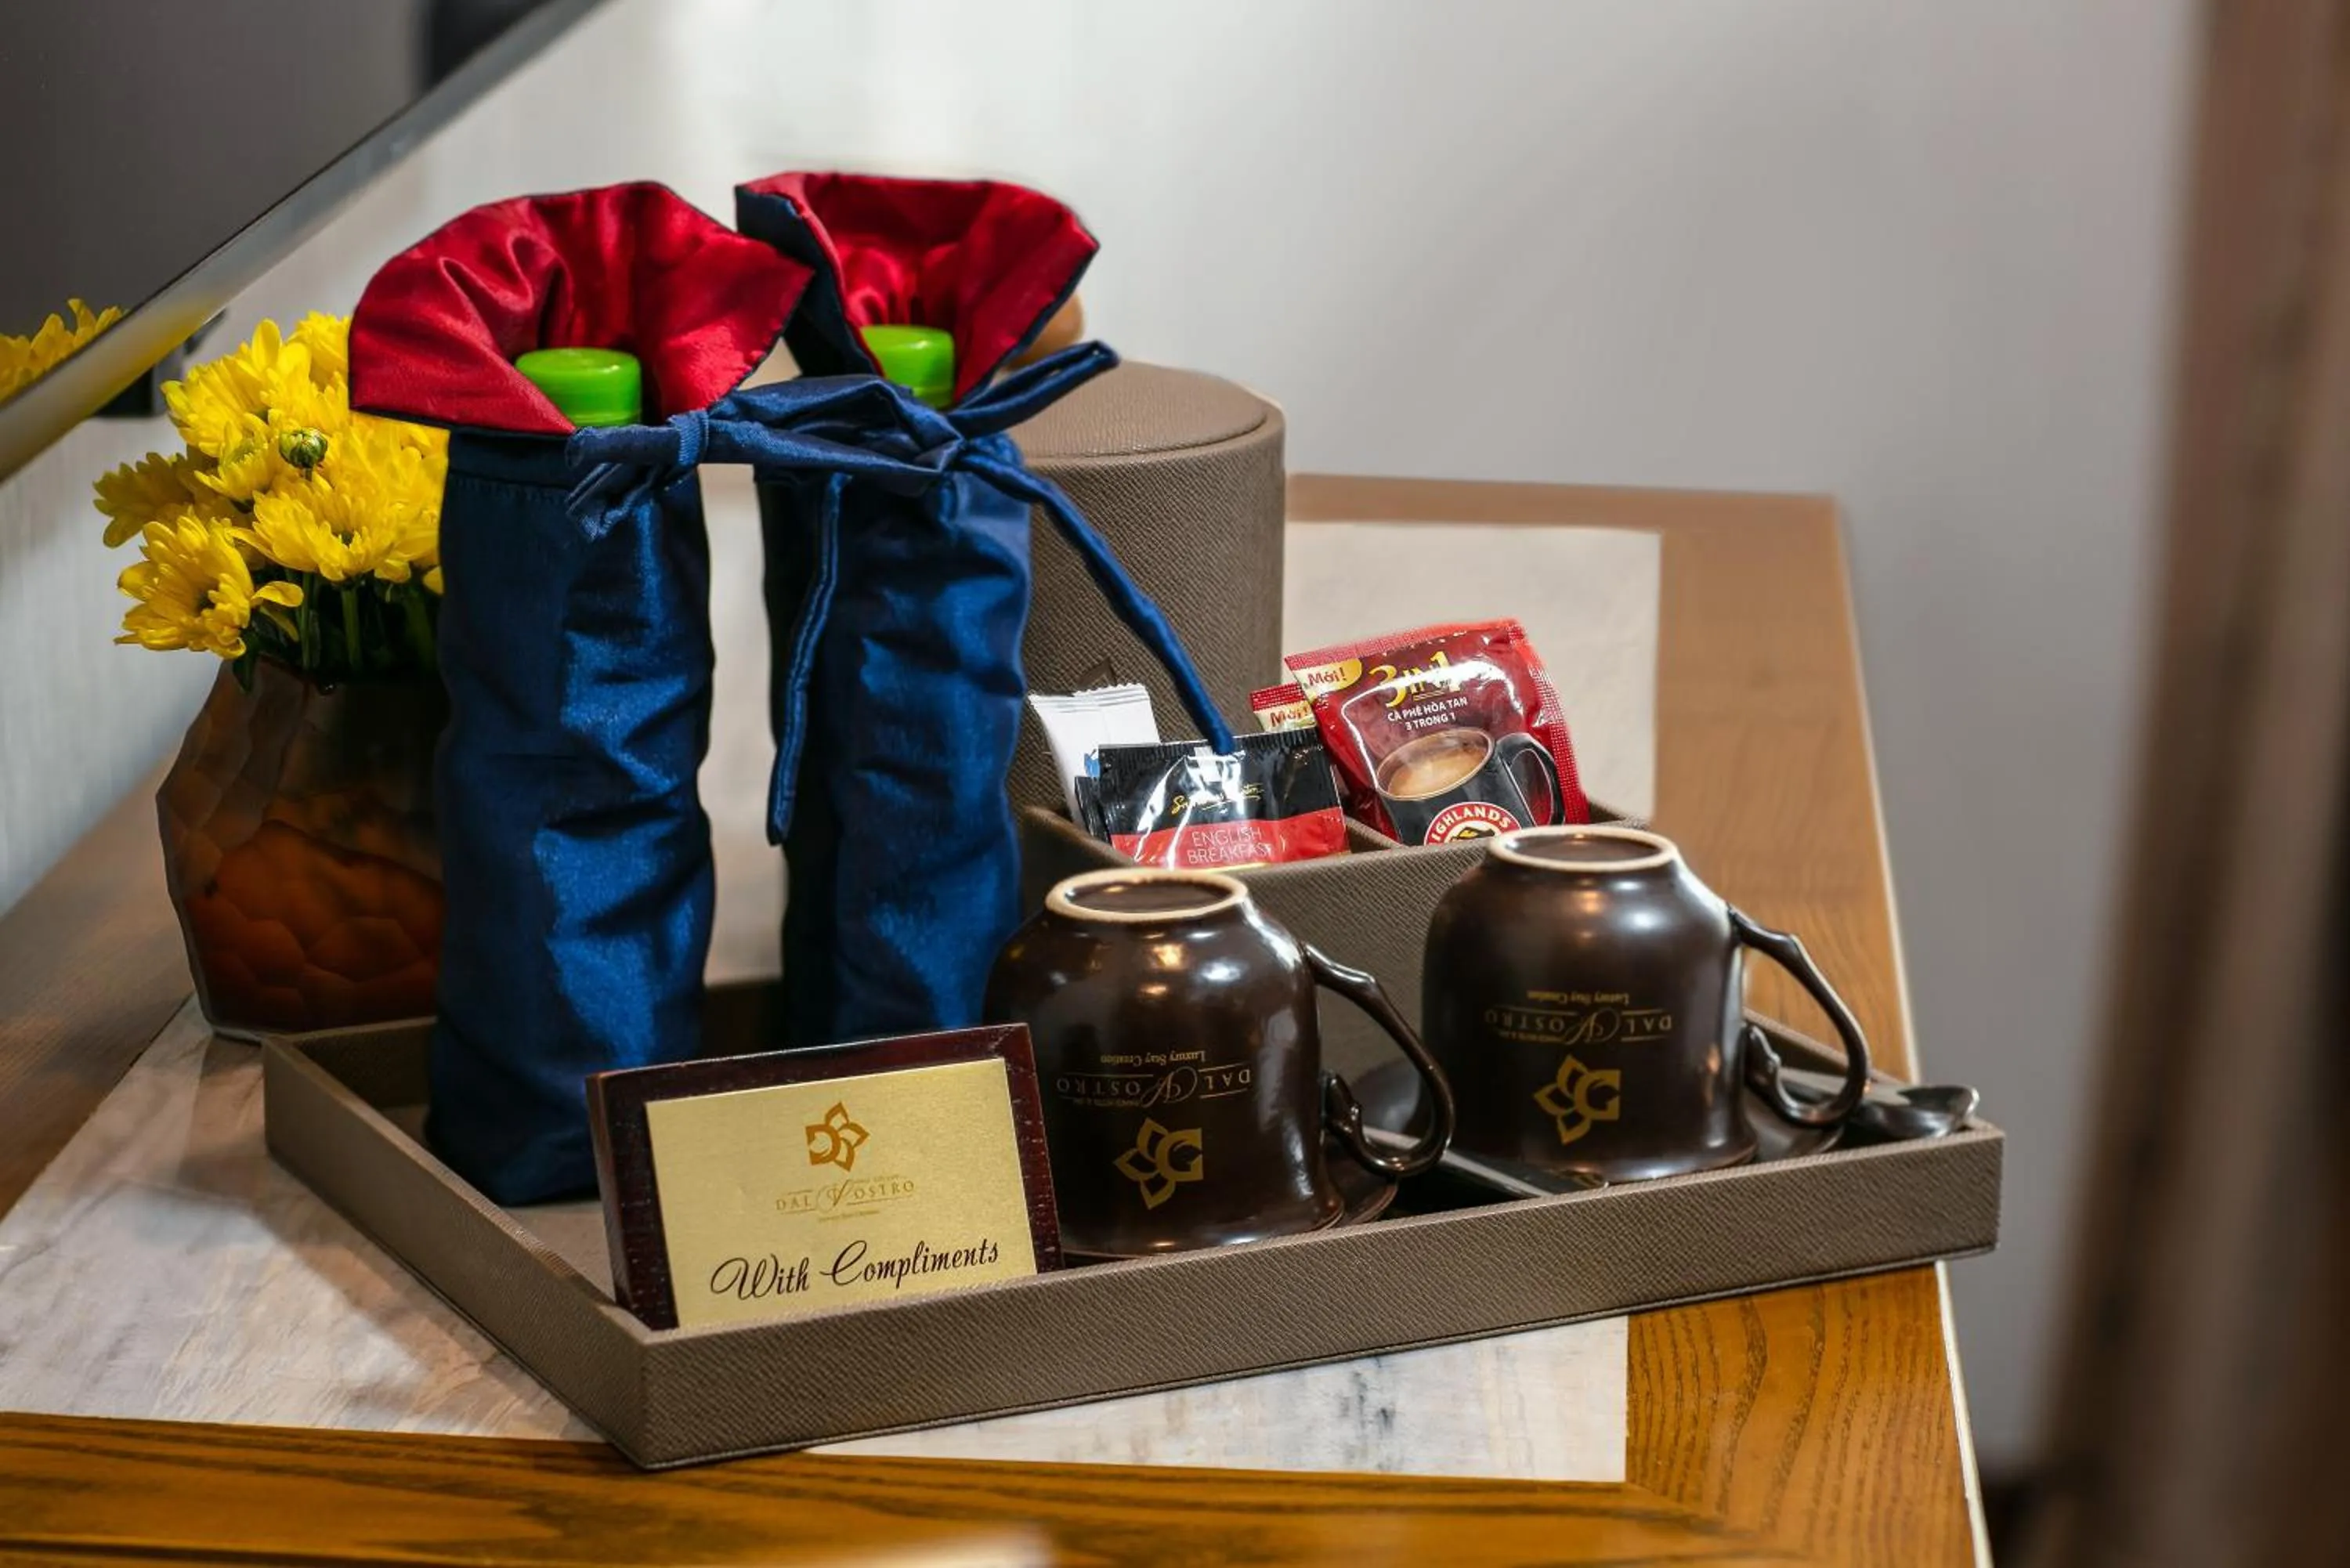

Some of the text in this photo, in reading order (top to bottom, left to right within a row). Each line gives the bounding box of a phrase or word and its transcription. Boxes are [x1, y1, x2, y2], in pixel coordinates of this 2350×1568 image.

[1423, 701, 1446, 714] HÒA
[1447, 696, 1468, 709] TAN
[1405, 712, 1456, 731] 3 TRONG 1
[1430, 806, 1511, 842] IGHLANDS
[1191, 826, 1262, 848] ENGLISH
[1186, 843, 1274, 865] BREAKFAST
[1625, 1014, 1672, 1033] DAL
[1145, 1052, 1167, 1066] Stay
[1169, 1050, 1206, 1065] Luxury
[1203, 1068, 1252, 1090] DAL
[775, 1179, 915, 1213] DAL VOSTRO
[710, 1238, 999, 1300] With Compliments
